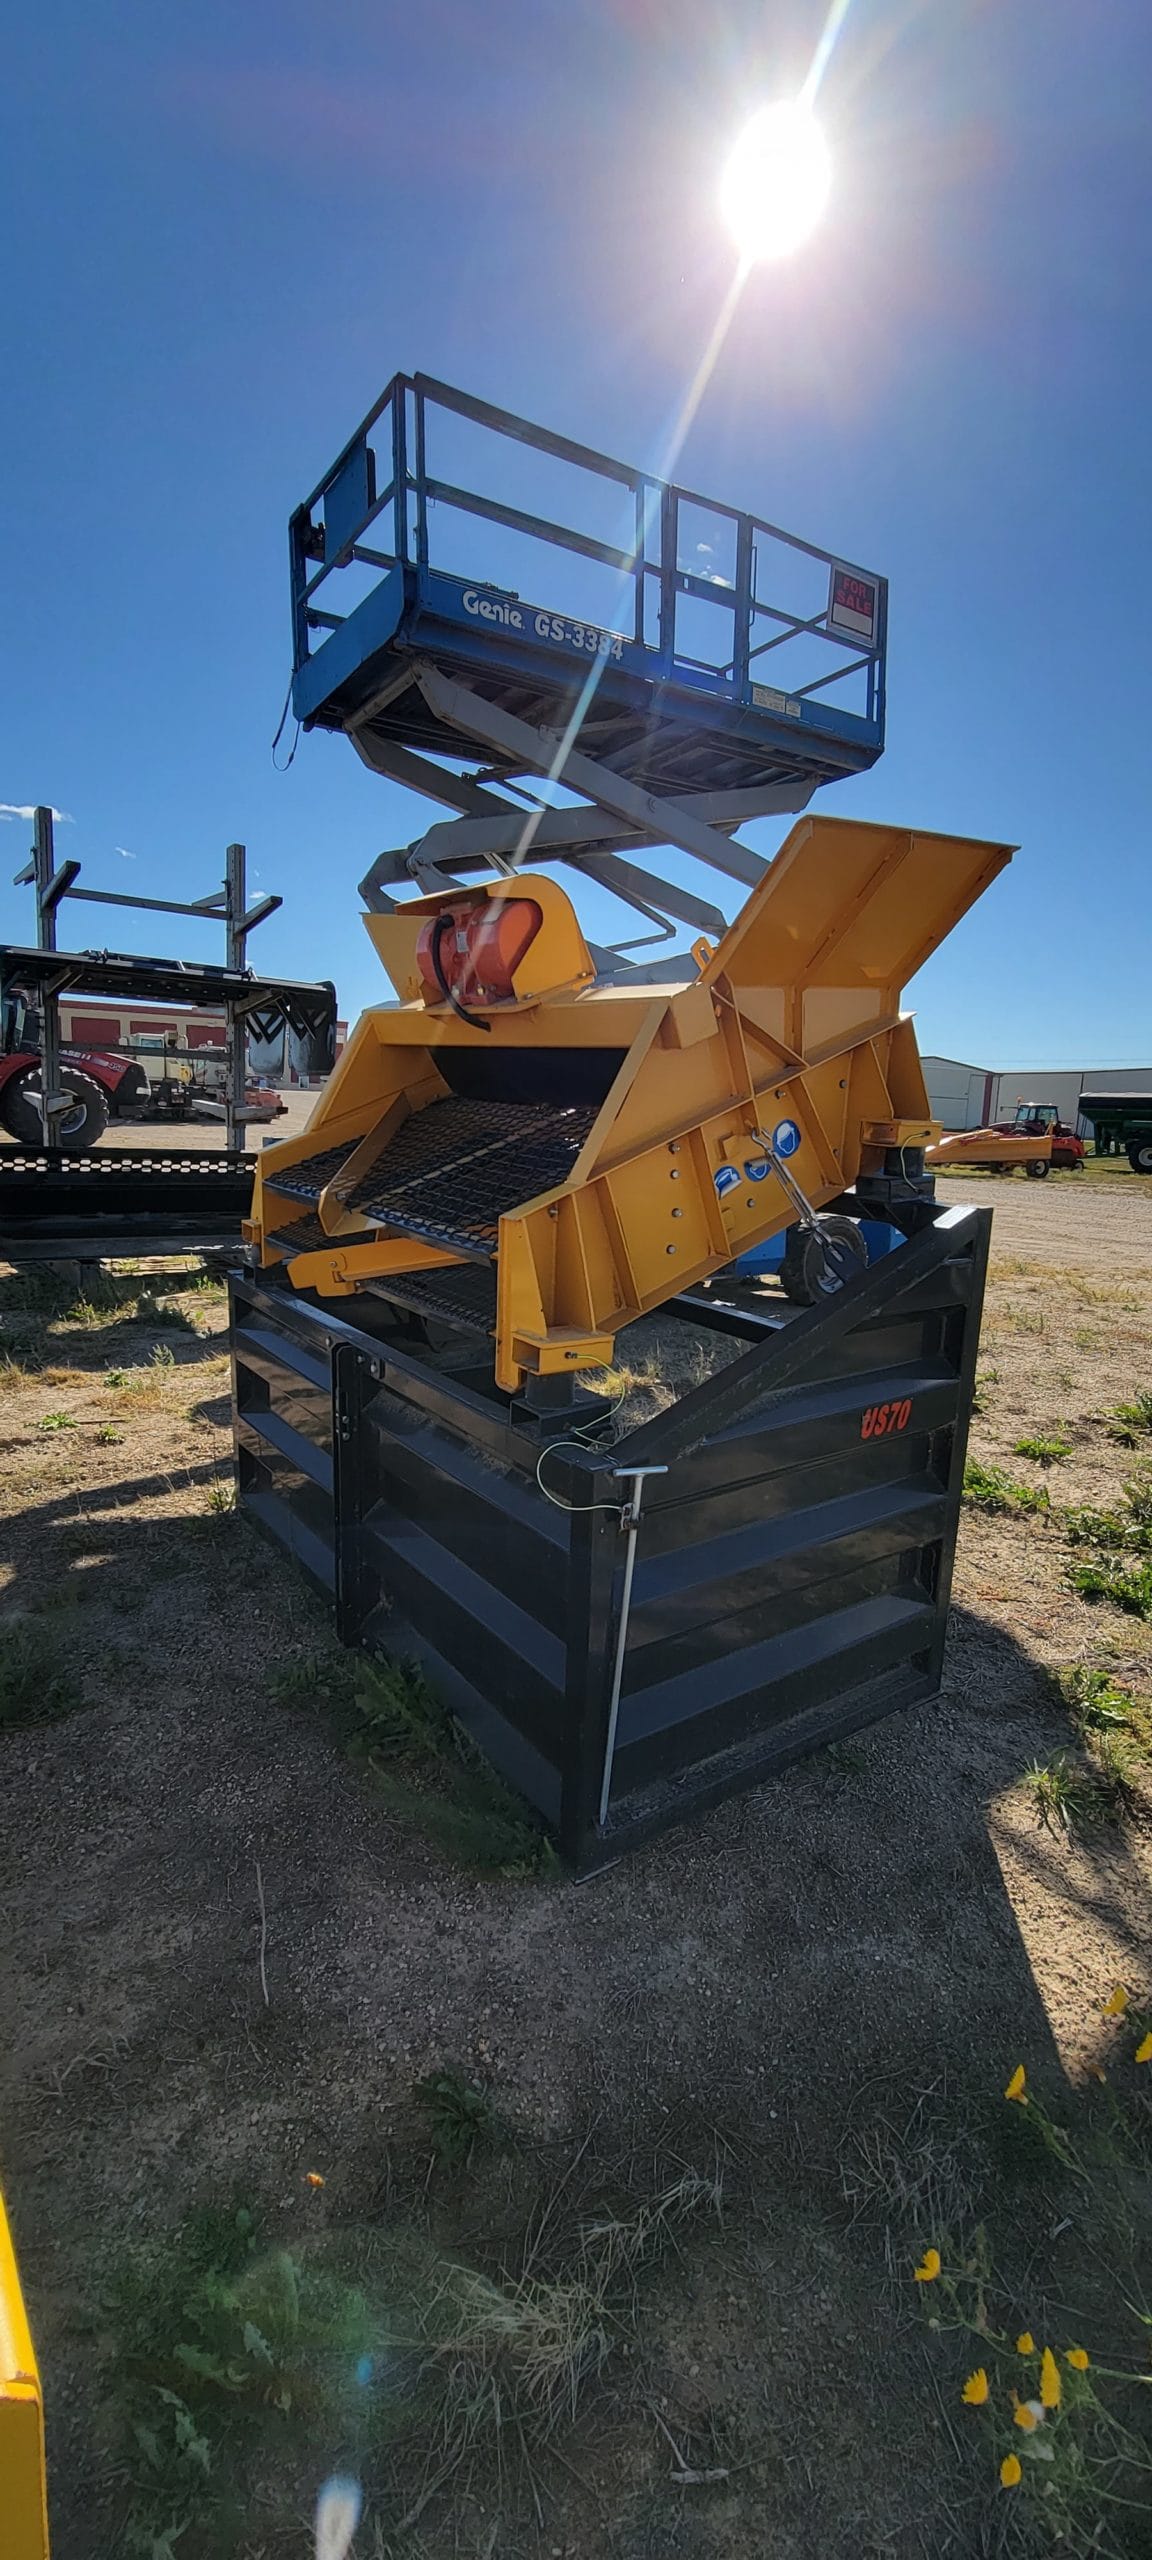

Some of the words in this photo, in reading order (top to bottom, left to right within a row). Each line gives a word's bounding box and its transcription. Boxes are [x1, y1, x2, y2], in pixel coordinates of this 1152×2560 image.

[836, 590, 872, 614] SALE
[843, 577, 866, 598] FOR
[462, 590, 523, 630] Genie
[535, 613, 623, 660] GS-3384
[861, 1398, 912, 1440] US70
